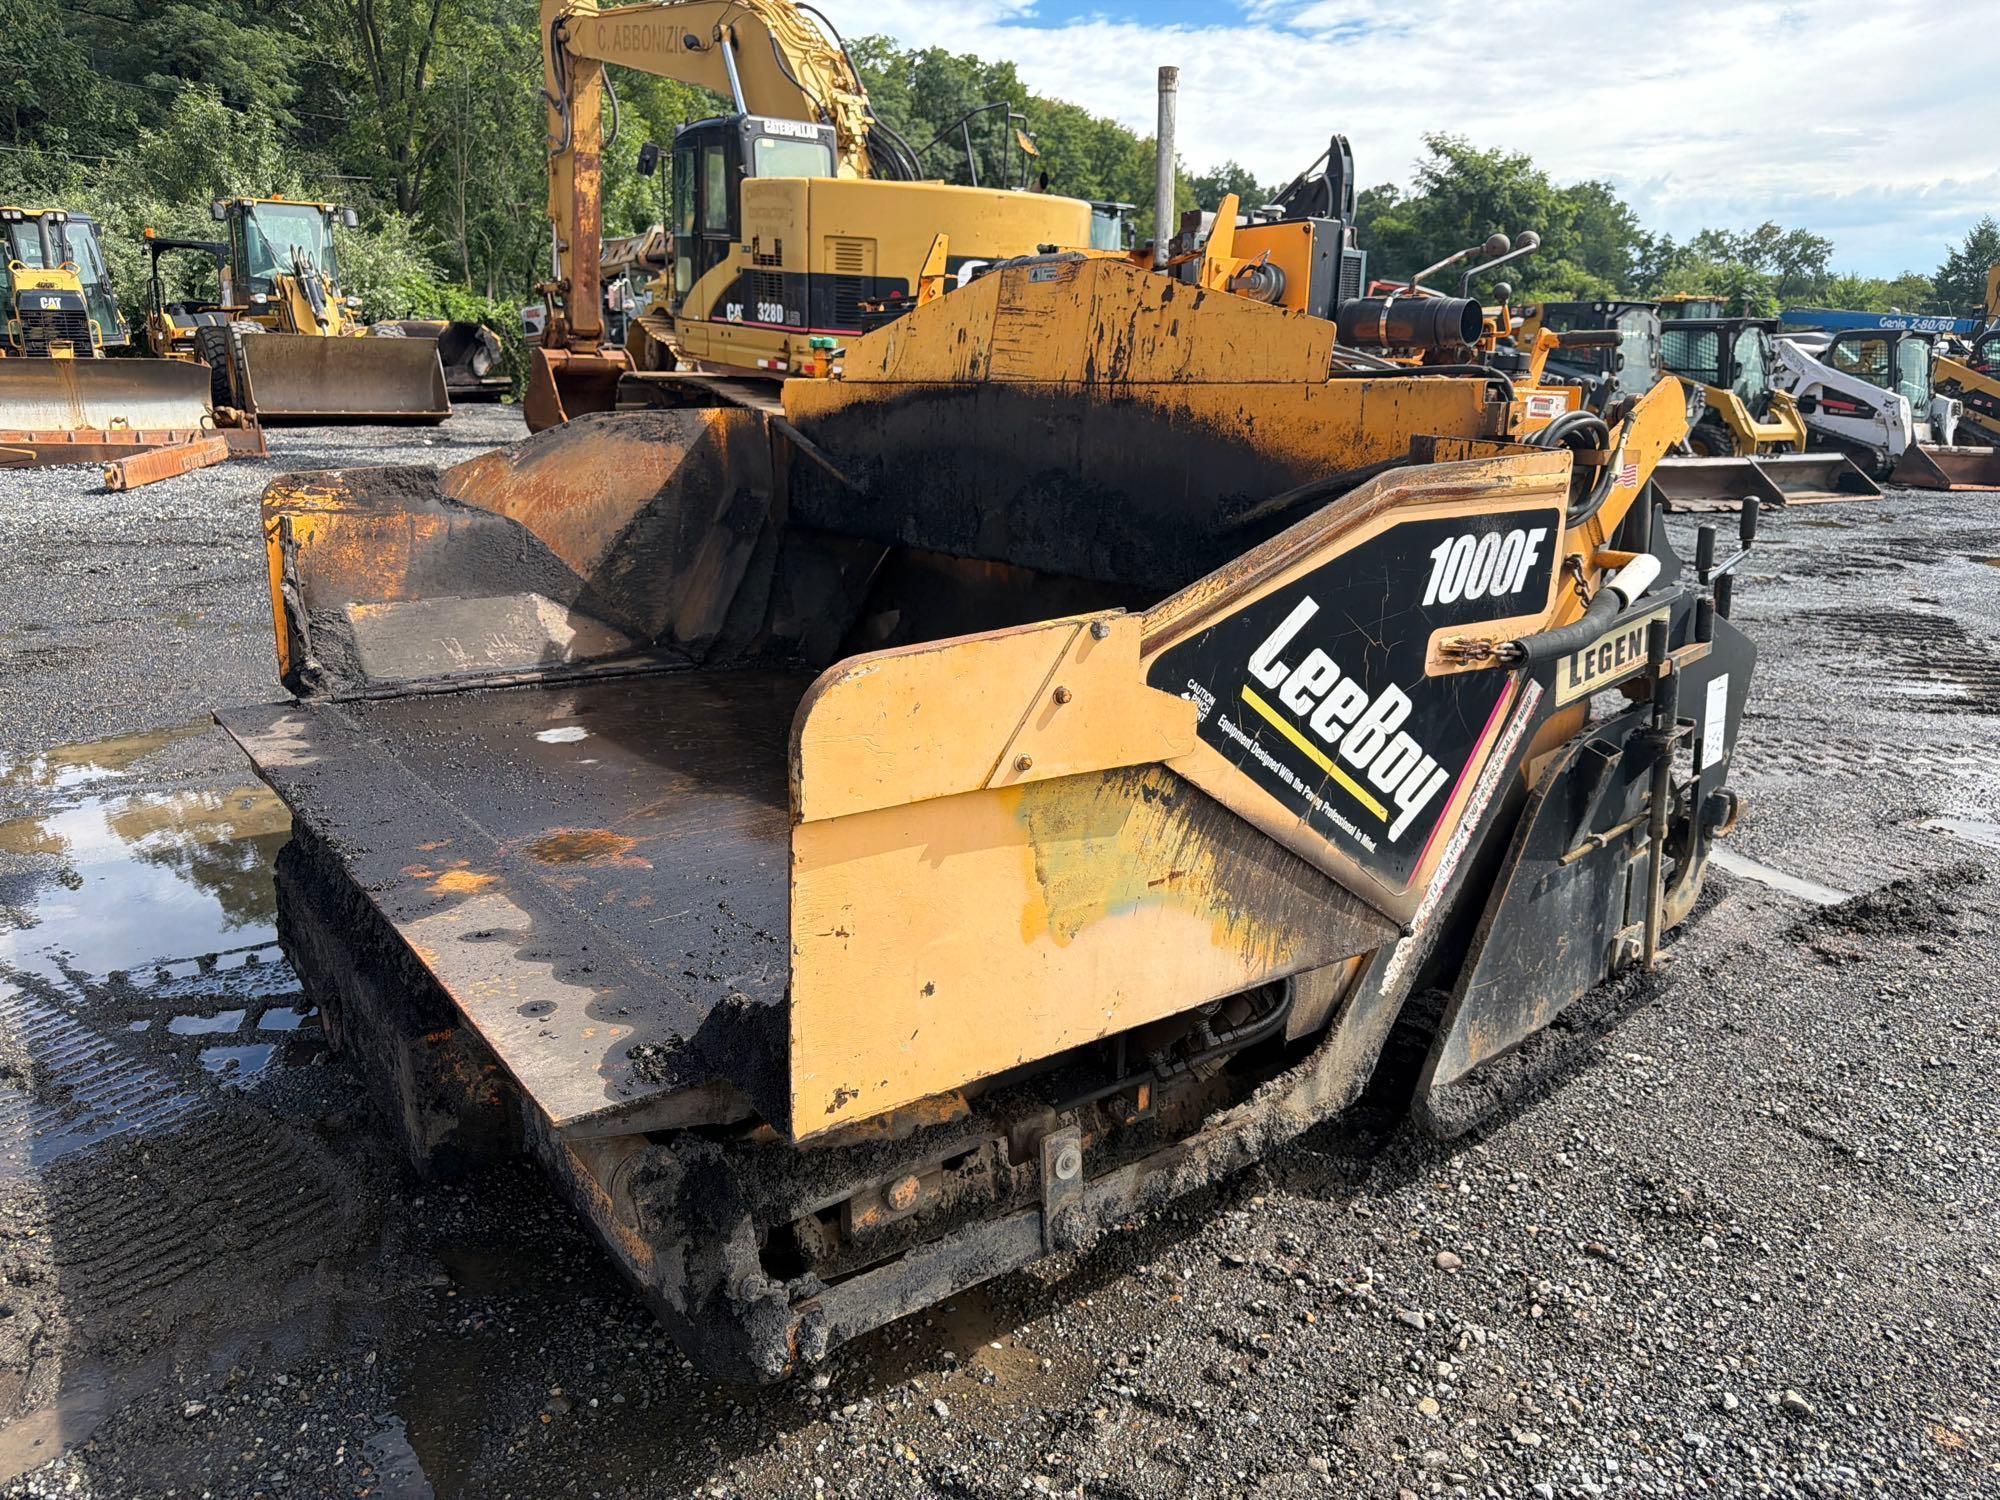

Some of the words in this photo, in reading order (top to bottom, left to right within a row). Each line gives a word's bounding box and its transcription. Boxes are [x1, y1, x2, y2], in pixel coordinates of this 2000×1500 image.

[764, 119, 818, 138] CATERPILLAR
[40, 297, 61, 309] CAT
[757, 302, 783, 322] 328D
[1880, 317, 1906, 328] Genie
[1910, 319, 1955, 331] Z-80/60
[1422, 528, 1547, 606] 1000F
[1187, 678, 1216, 706] CAUTION
[1191, 693, 1211, 714] PINCH
[1248, 595, 1450, 843] LeeBoy
[1217, 713, 1253, 750] Equipment
[1250, 741, 1283, 774] Designed
[1279, 763, 1295, 784] With
[1292, 775, 1304, 792] the
[1301, 785, 1324, 811] Paving
[1321, 801, 1358, 836] Professional
[1354, 827, 1363, 841] In
